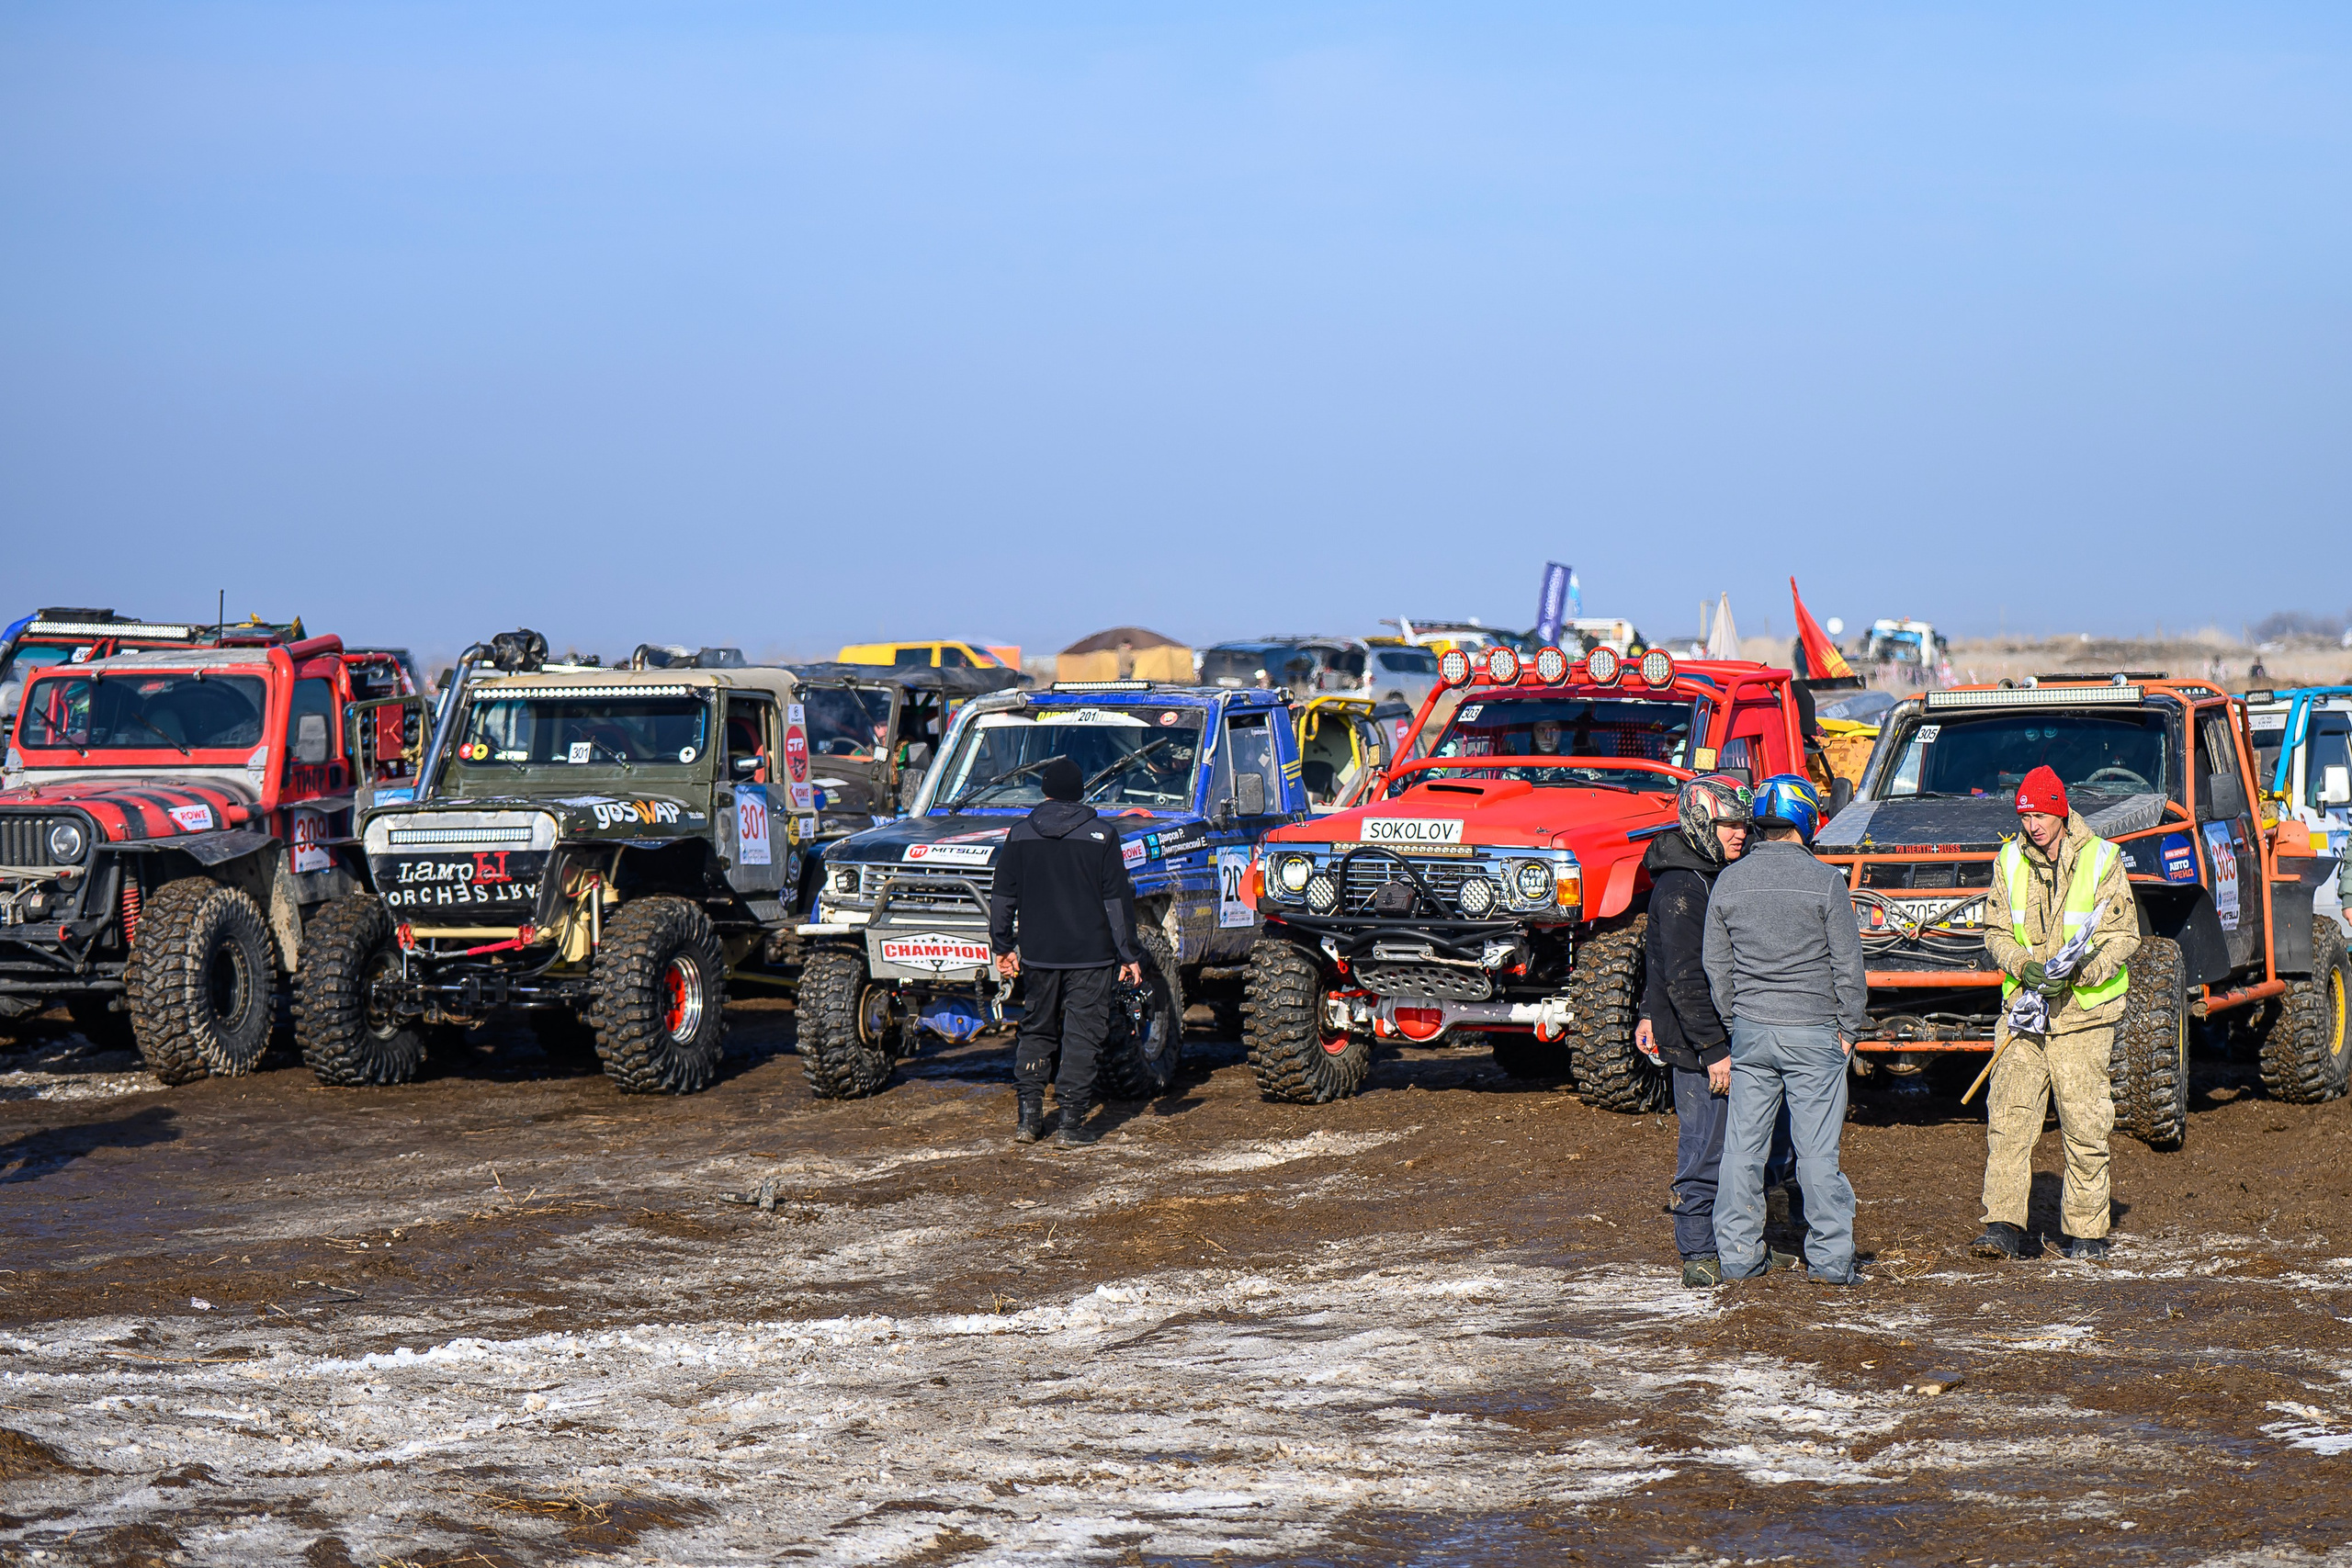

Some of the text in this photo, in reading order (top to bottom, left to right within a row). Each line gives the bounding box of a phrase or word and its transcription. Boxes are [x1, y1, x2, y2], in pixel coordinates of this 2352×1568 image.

[1078, 711, 1097, 722] 201
[1461, 708, 1480, 719] 303
[1917, 728, 1938, 740] 305
[571, 746, 589, 760] 301
[179, 809, 208, 820] ROWE
[741, 804, 767, 840] 301
[1369, 822, 1454, 840] SOKOLOV
[931, 847, 989, 855] MITSUJI
[1122, 845, 1143, 859] ROWE
[2168, 859, 2189, 872] АВТО
[2212, 842, 2236, 884] 305
[2168, 868, 2195, 880] ТРЕЙД
[1223, 864, 1249, 902] 20
[884, 944, 989, 961] CHAMPION
